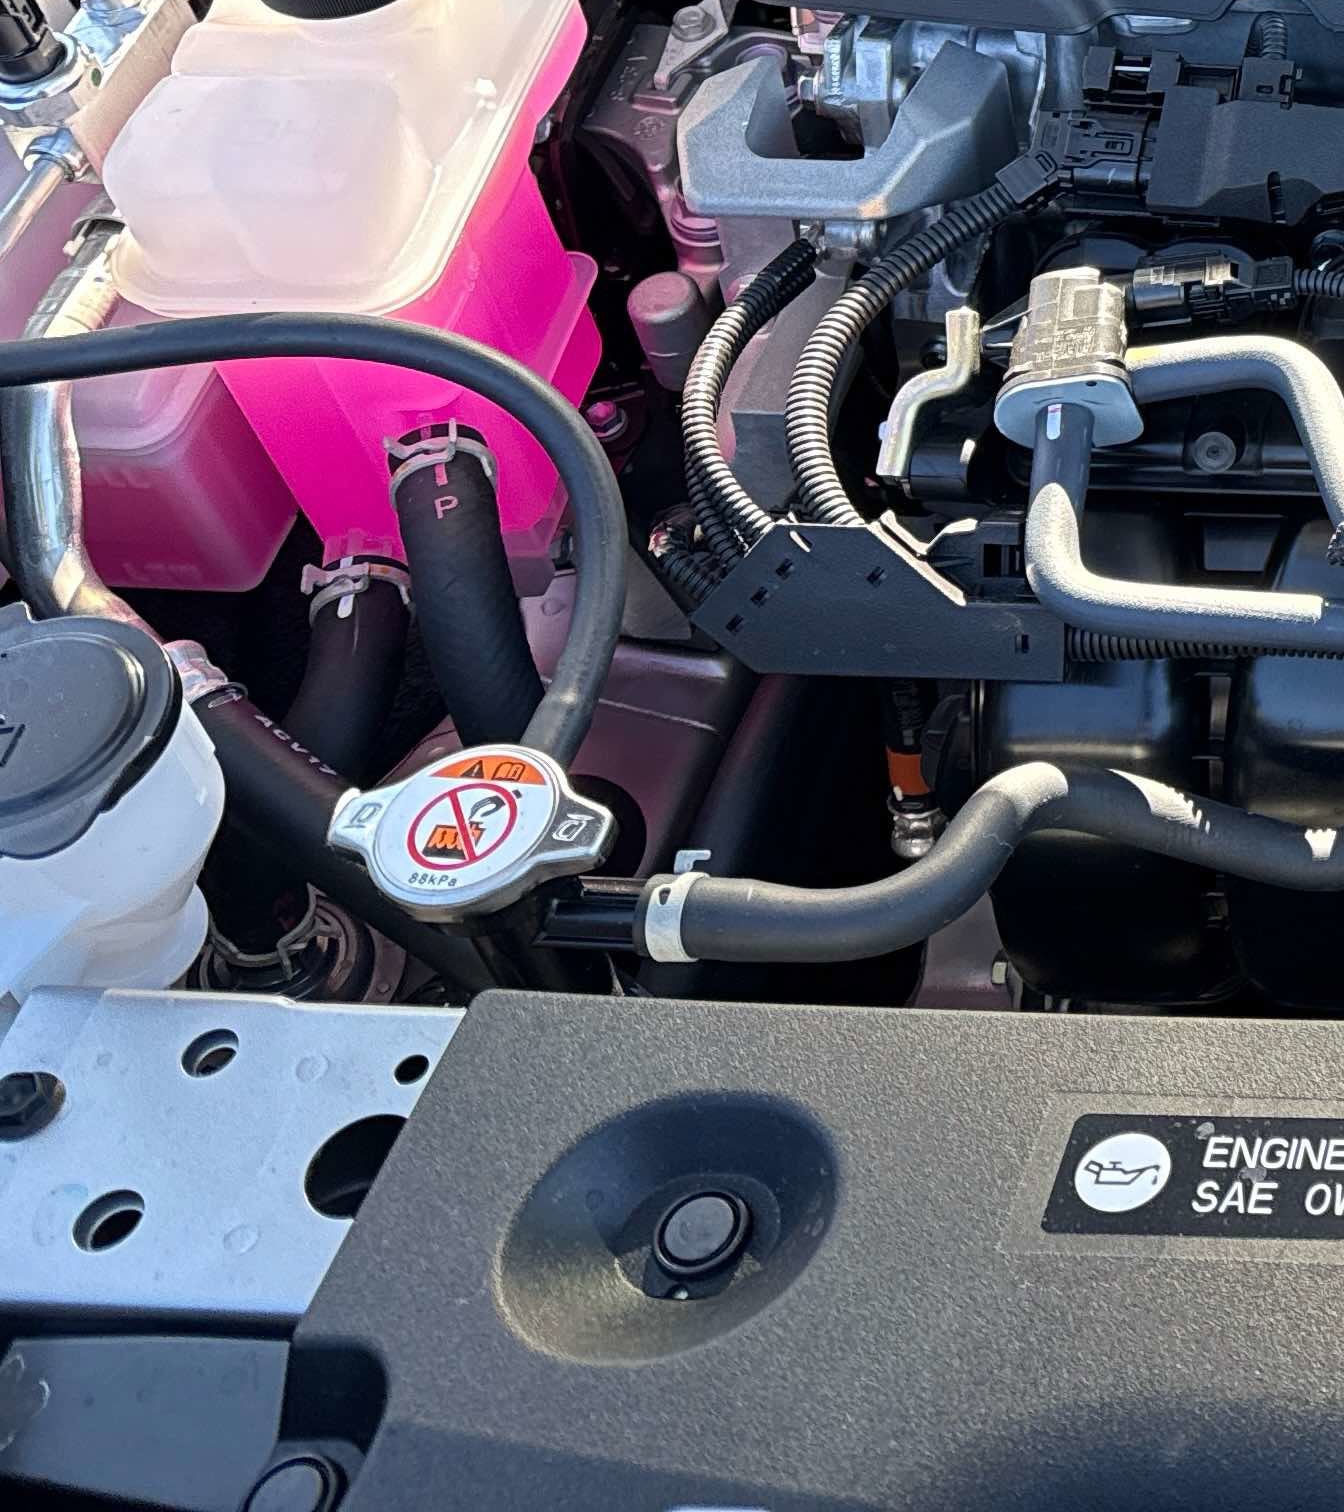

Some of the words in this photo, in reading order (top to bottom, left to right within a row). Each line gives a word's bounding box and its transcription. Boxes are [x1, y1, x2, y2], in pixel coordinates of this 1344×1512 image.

[434, 495, 460, 520] P
[407, 871, 458, 888] 88kPa
[1190, 1180, 1280, 1215] SAE
